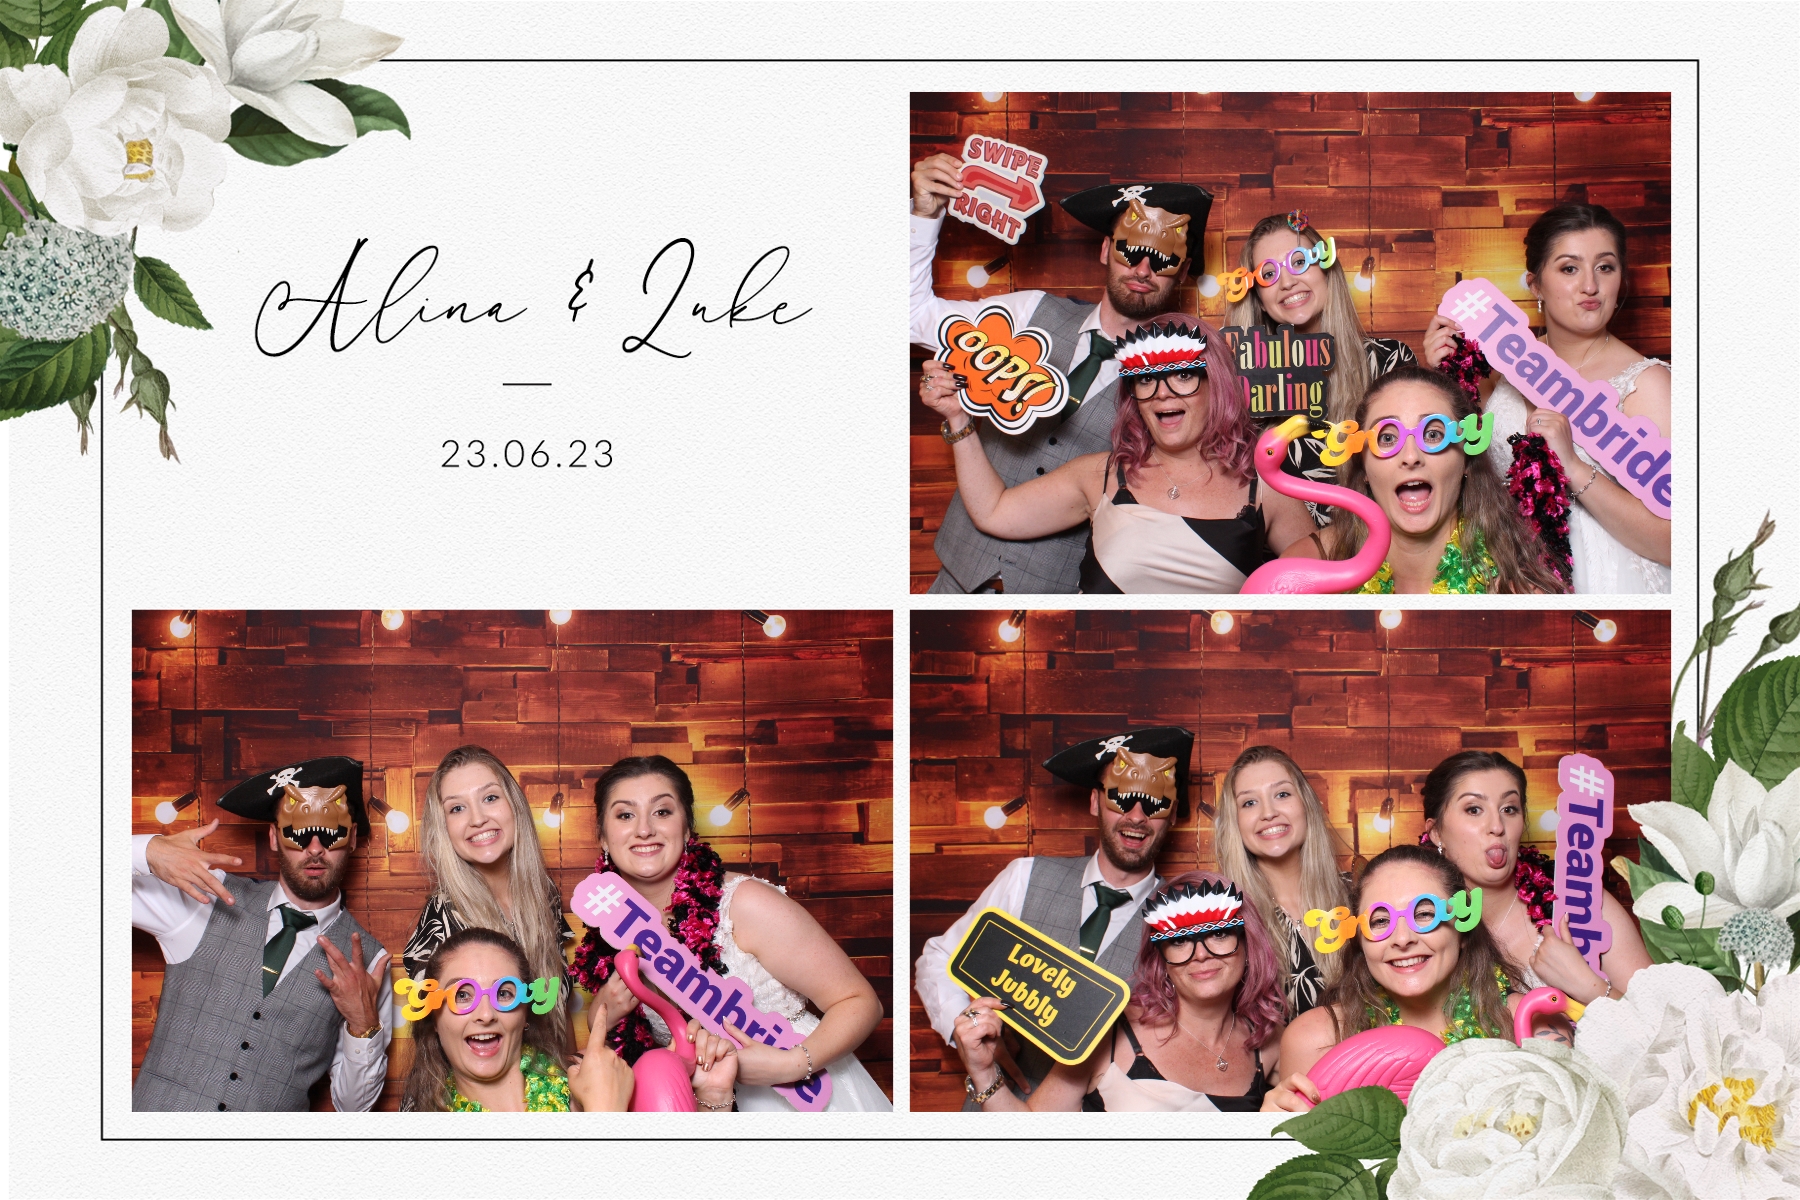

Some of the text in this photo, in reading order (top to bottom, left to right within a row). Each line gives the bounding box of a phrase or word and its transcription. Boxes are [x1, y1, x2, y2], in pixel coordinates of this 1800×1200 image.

[968, 138, 1042, 179] SWIPE
[953, 192, 1022, 239] RIGHT
[954, 330, 1058, 416] OOPS!
[1224, 330, 1331, 369] Fabulous
[1564, 765, 1605, 965] #Teamb
[583, 883, 822, 1104] #Teambrie
[990, 968, 1059, 1028] Jubbly
[1007, 943, 1077, 999] Lovely
